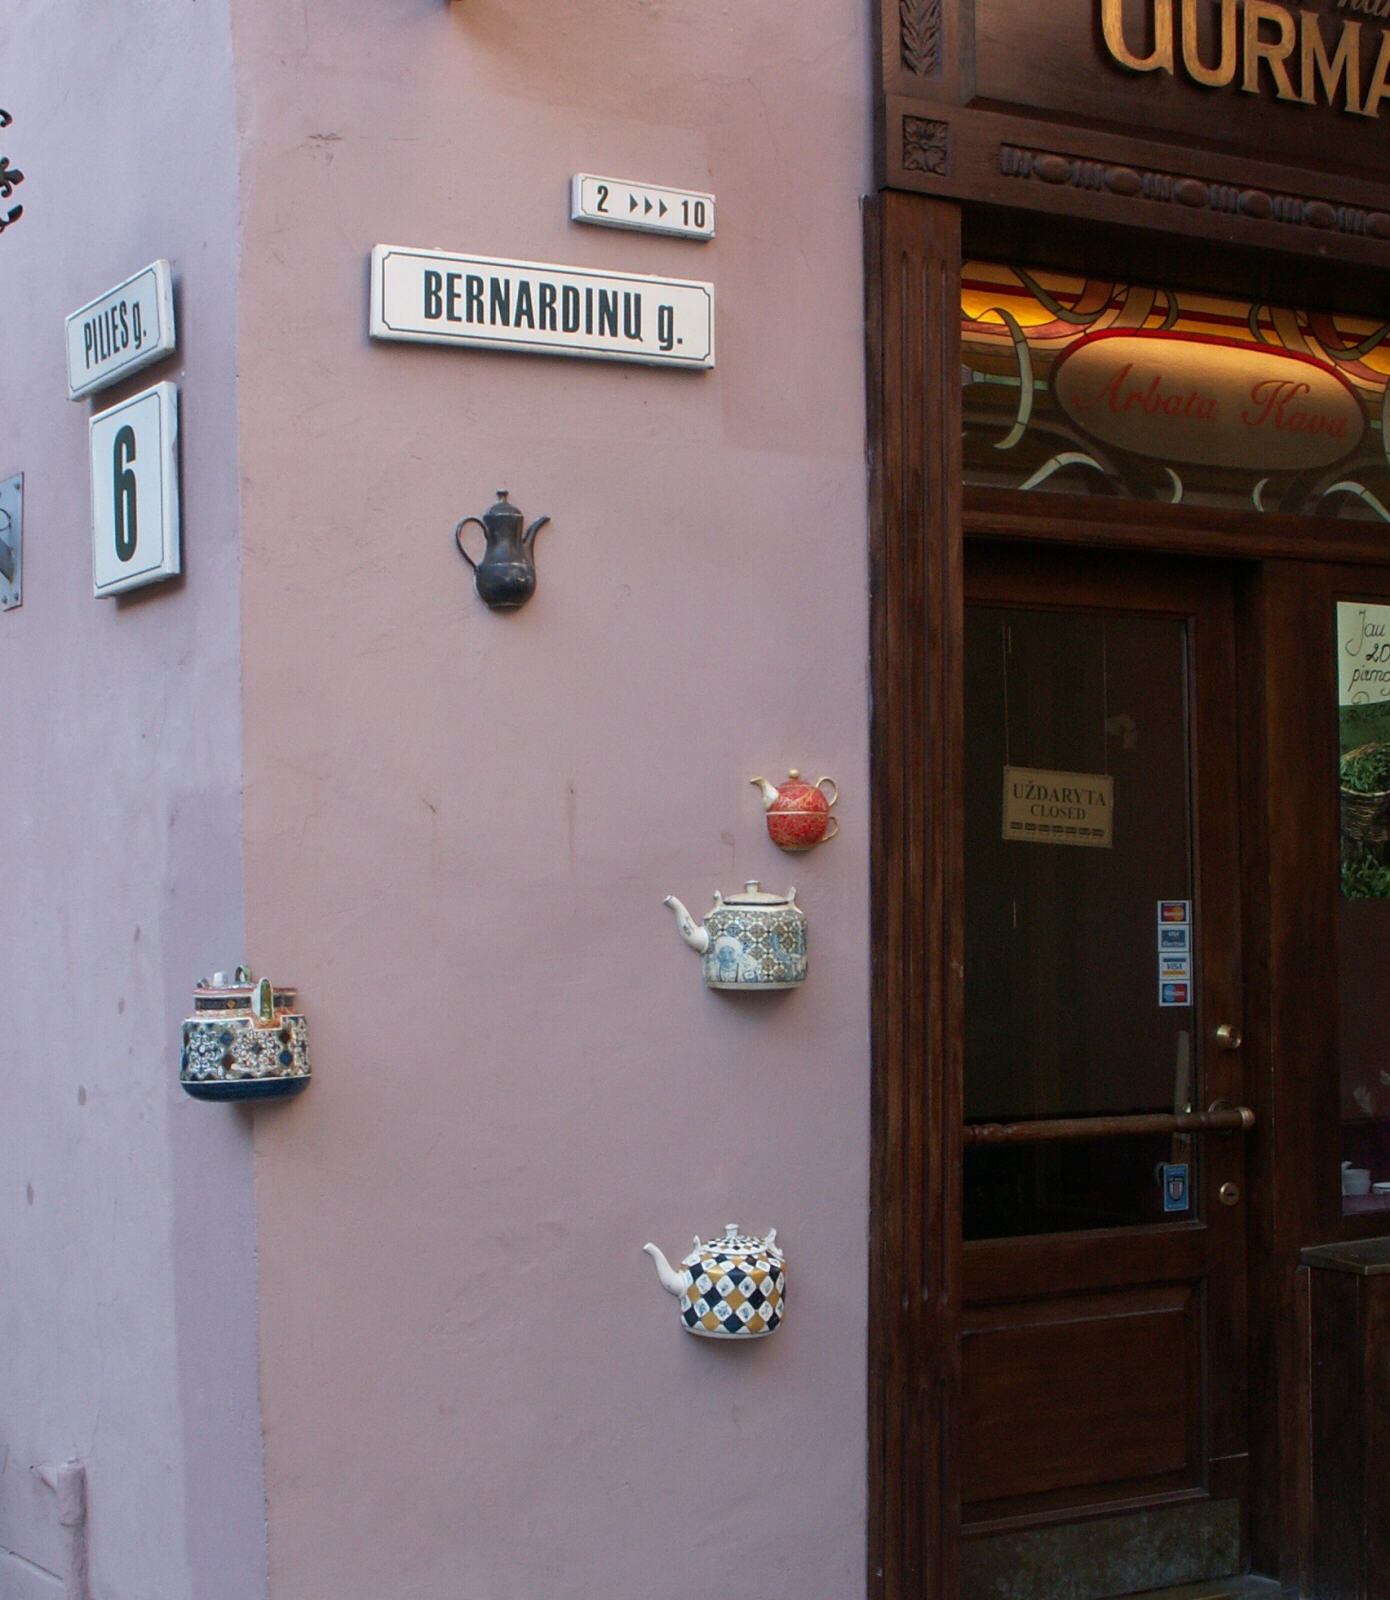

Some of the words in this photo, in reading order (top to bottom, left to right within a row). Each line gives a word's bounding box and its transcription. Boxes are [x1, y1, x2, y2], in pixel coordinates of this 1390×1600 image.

[597, 185, 609, 213] 2
[681, 200, 706, 229] 10
[83, 300, 130, 370] PILIES
[133, 302, 147, 350] g.
[657, 304, 683, 351] g.
[1073, 362, 1218, 421] Arbata
[1241, 379, 1349, 438] Kava
[113, 424, 137, 563] 6
[1345, 608, 1385, 657] Jau
[1013, 780, 1107, 807] UŽDARYTA
[1030, 803, 1087, 820] CLOSED
